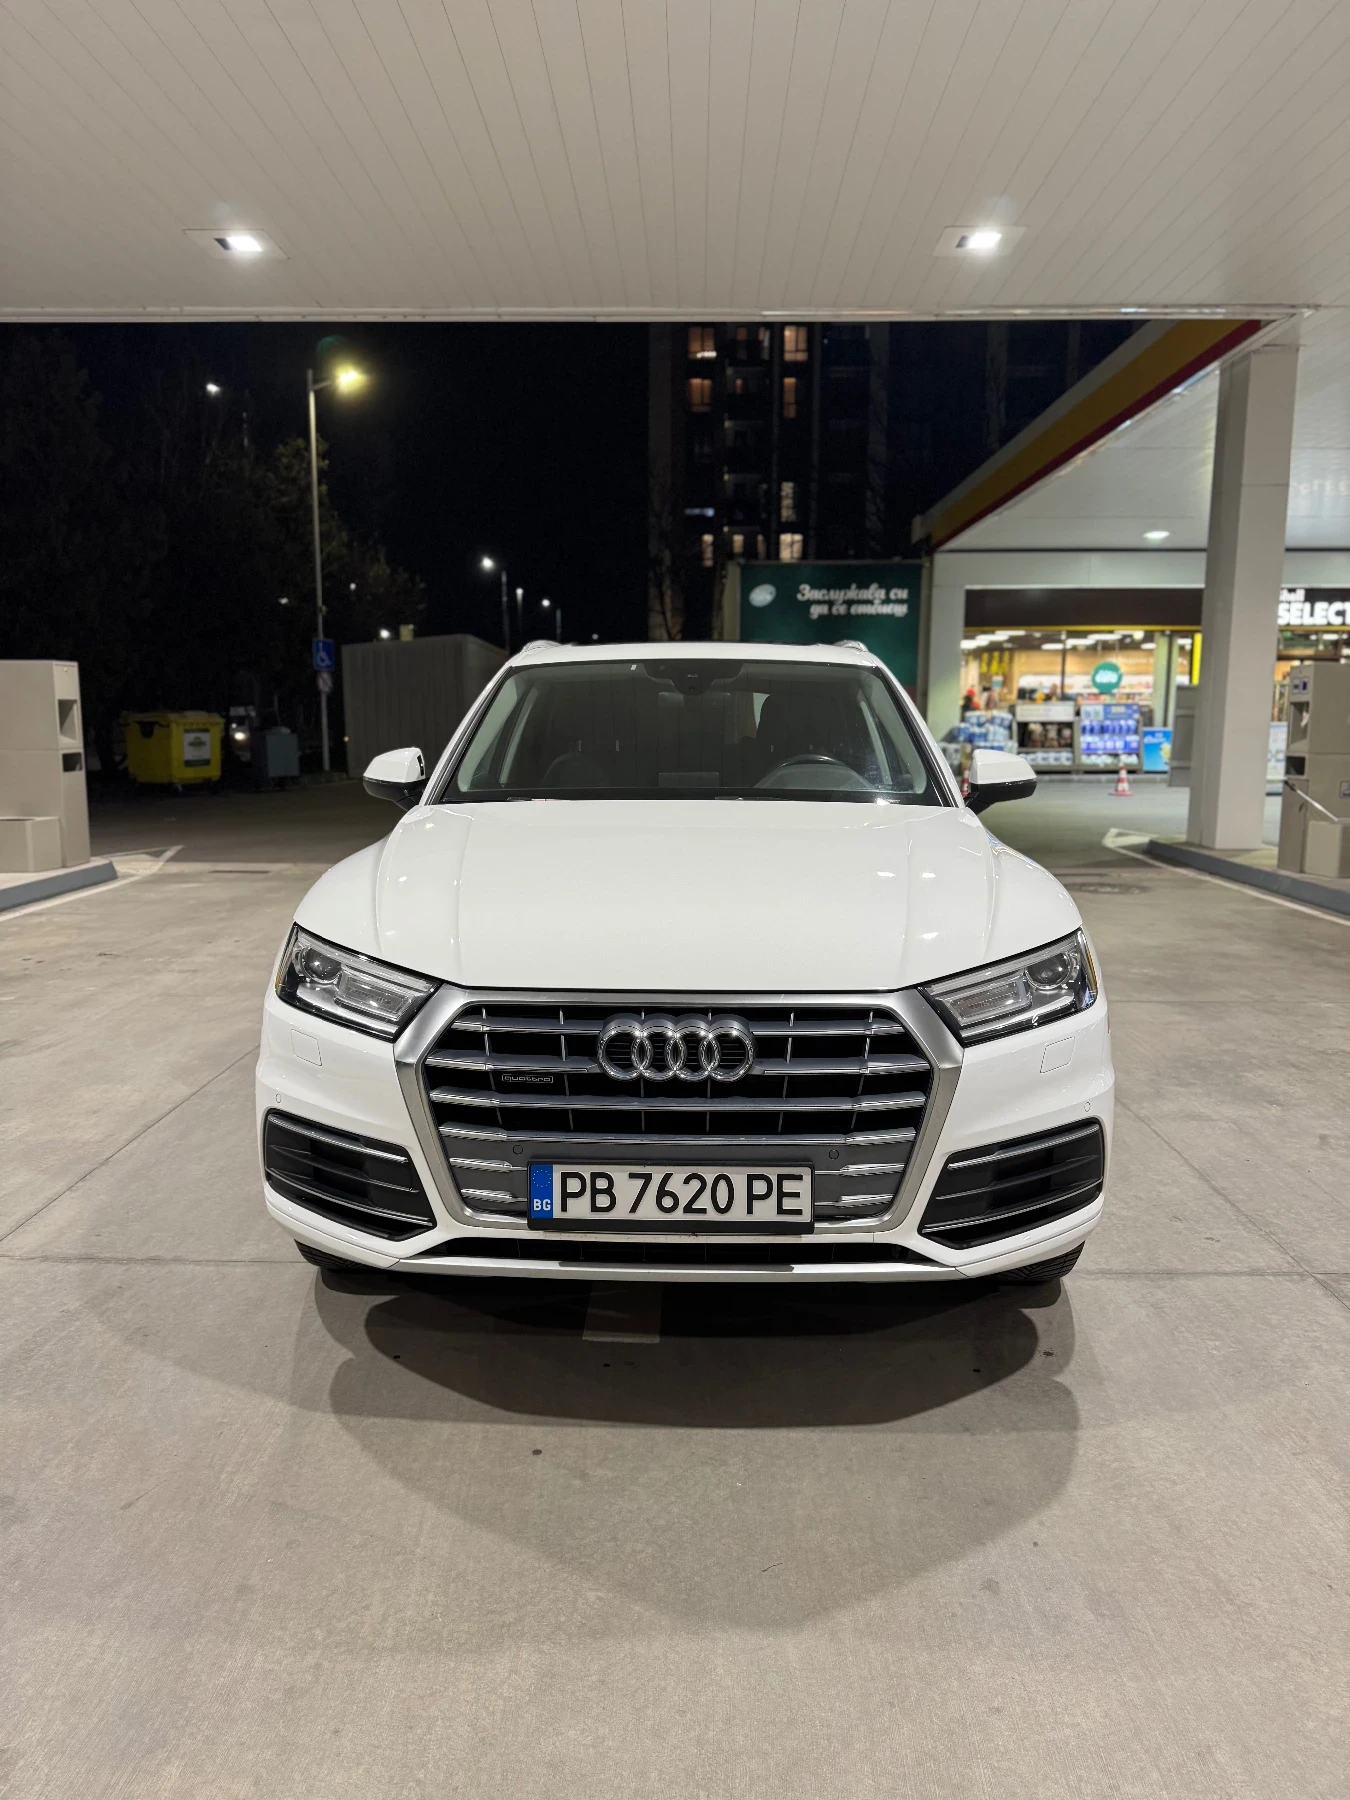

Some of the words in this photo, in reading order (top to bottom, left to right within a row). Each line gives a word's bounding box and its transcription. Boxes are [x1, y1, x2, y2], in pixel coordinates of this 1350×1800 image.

[1280, 588, 1305, 601] hell
[560, 1171, 617, 1213] PB
[628, 1172, 735, 1215] 7620
[746, 1173, 803, 1215] PE
[533, 1199, 551, 1211] BG
